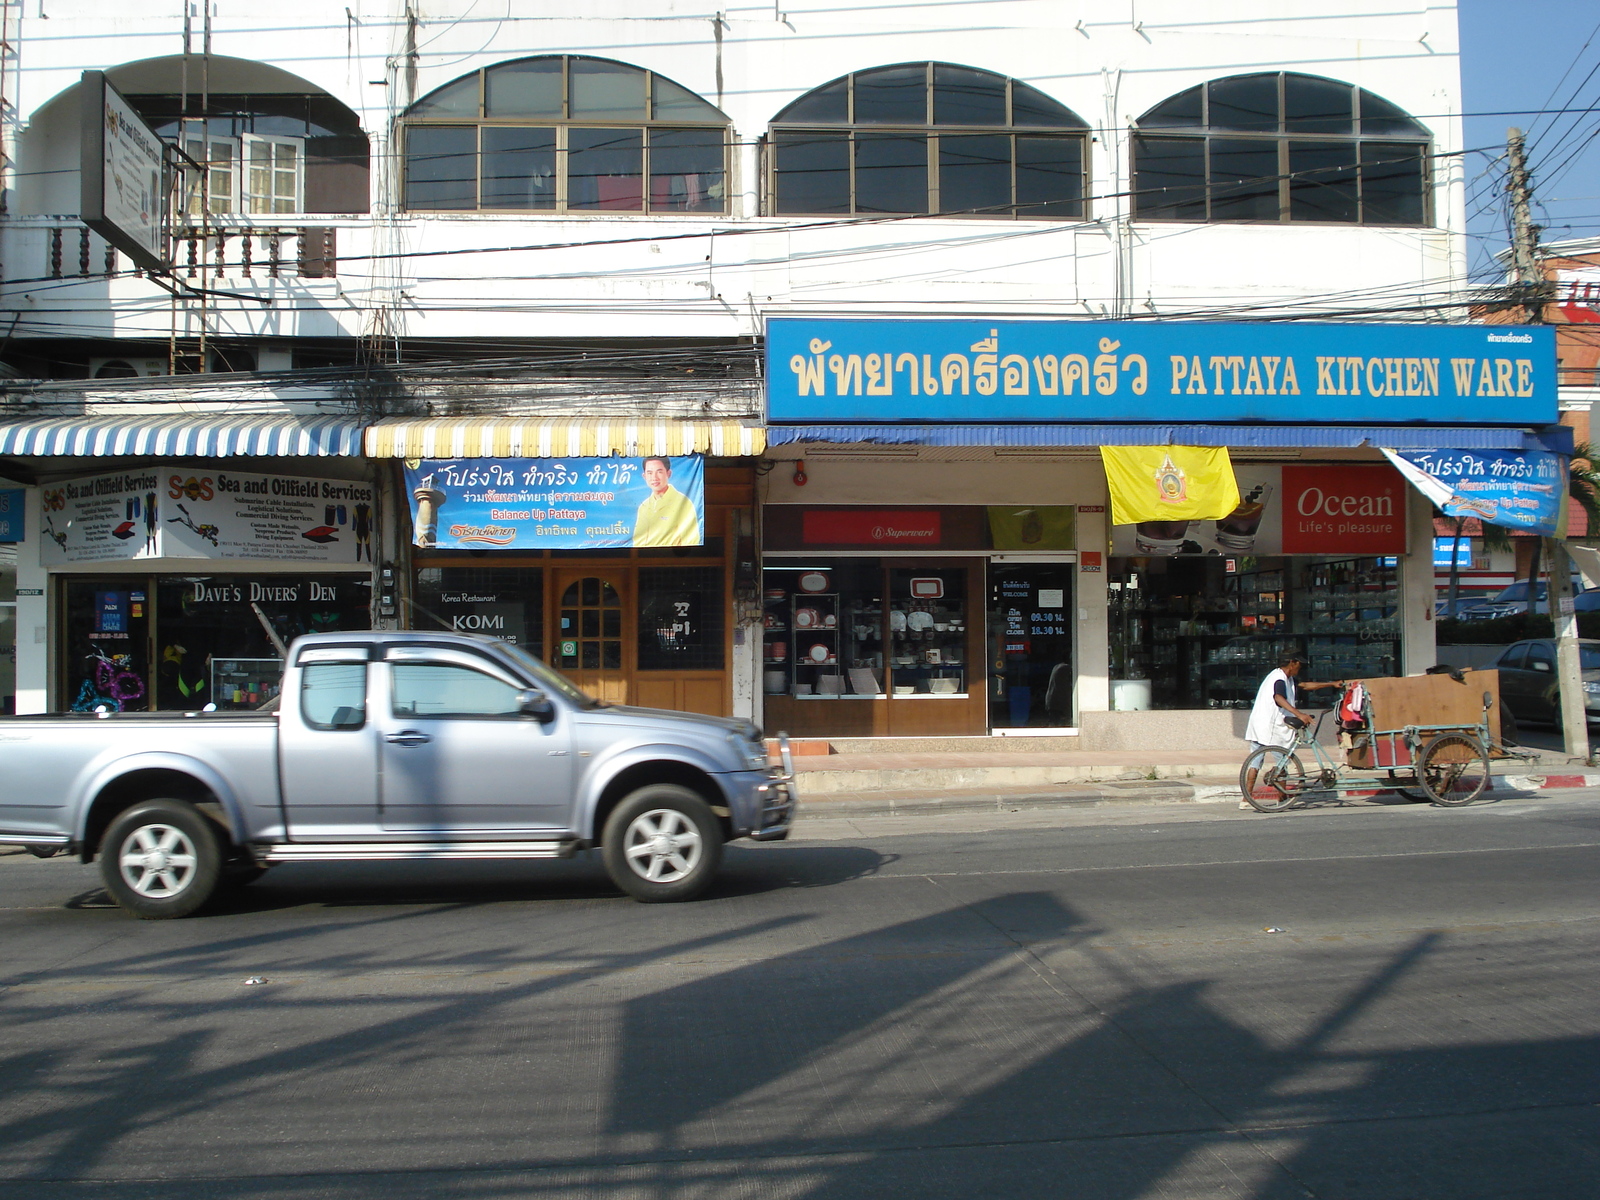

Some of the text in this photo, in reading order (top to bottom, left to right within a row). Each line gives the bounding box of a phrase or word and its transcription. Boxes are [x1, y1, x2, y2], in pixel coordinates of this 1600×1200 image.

[790, 328, 1148, 396] พัทยาเครื่องครัว
[1170, 355, 1534, 397] PATTAYA KITCHEN WARE
[522, 463, 578, 486] ทำจริง
[67, 483, 79, 500] Sea
[80, 480, 94, 497] and
[95, 476, 123, 496] Oilfield
[124, 472, 157, 492] Services
[217, 474, 241, 493] Sea
[244, 477, 269, 495] and
[271, 479, 319, 499] Oilfield
[321, 481, 372, 501] Services
[247, 504, 275, 512] Logistical
[1297, 487, 1394, 516] Ocean
[235, 511, 269, 519] Commercial
[270, 513, 289, 521] Diving
[491, 509, 586, 522] Balance Up Pattaya
[885, 527, 934, 538] Superware
[1299, 521, 1393, 535] Life's pleasure
[441, 592, 497, 603] Korea Restaurant
[453, 614, 504, 630] KOMI
